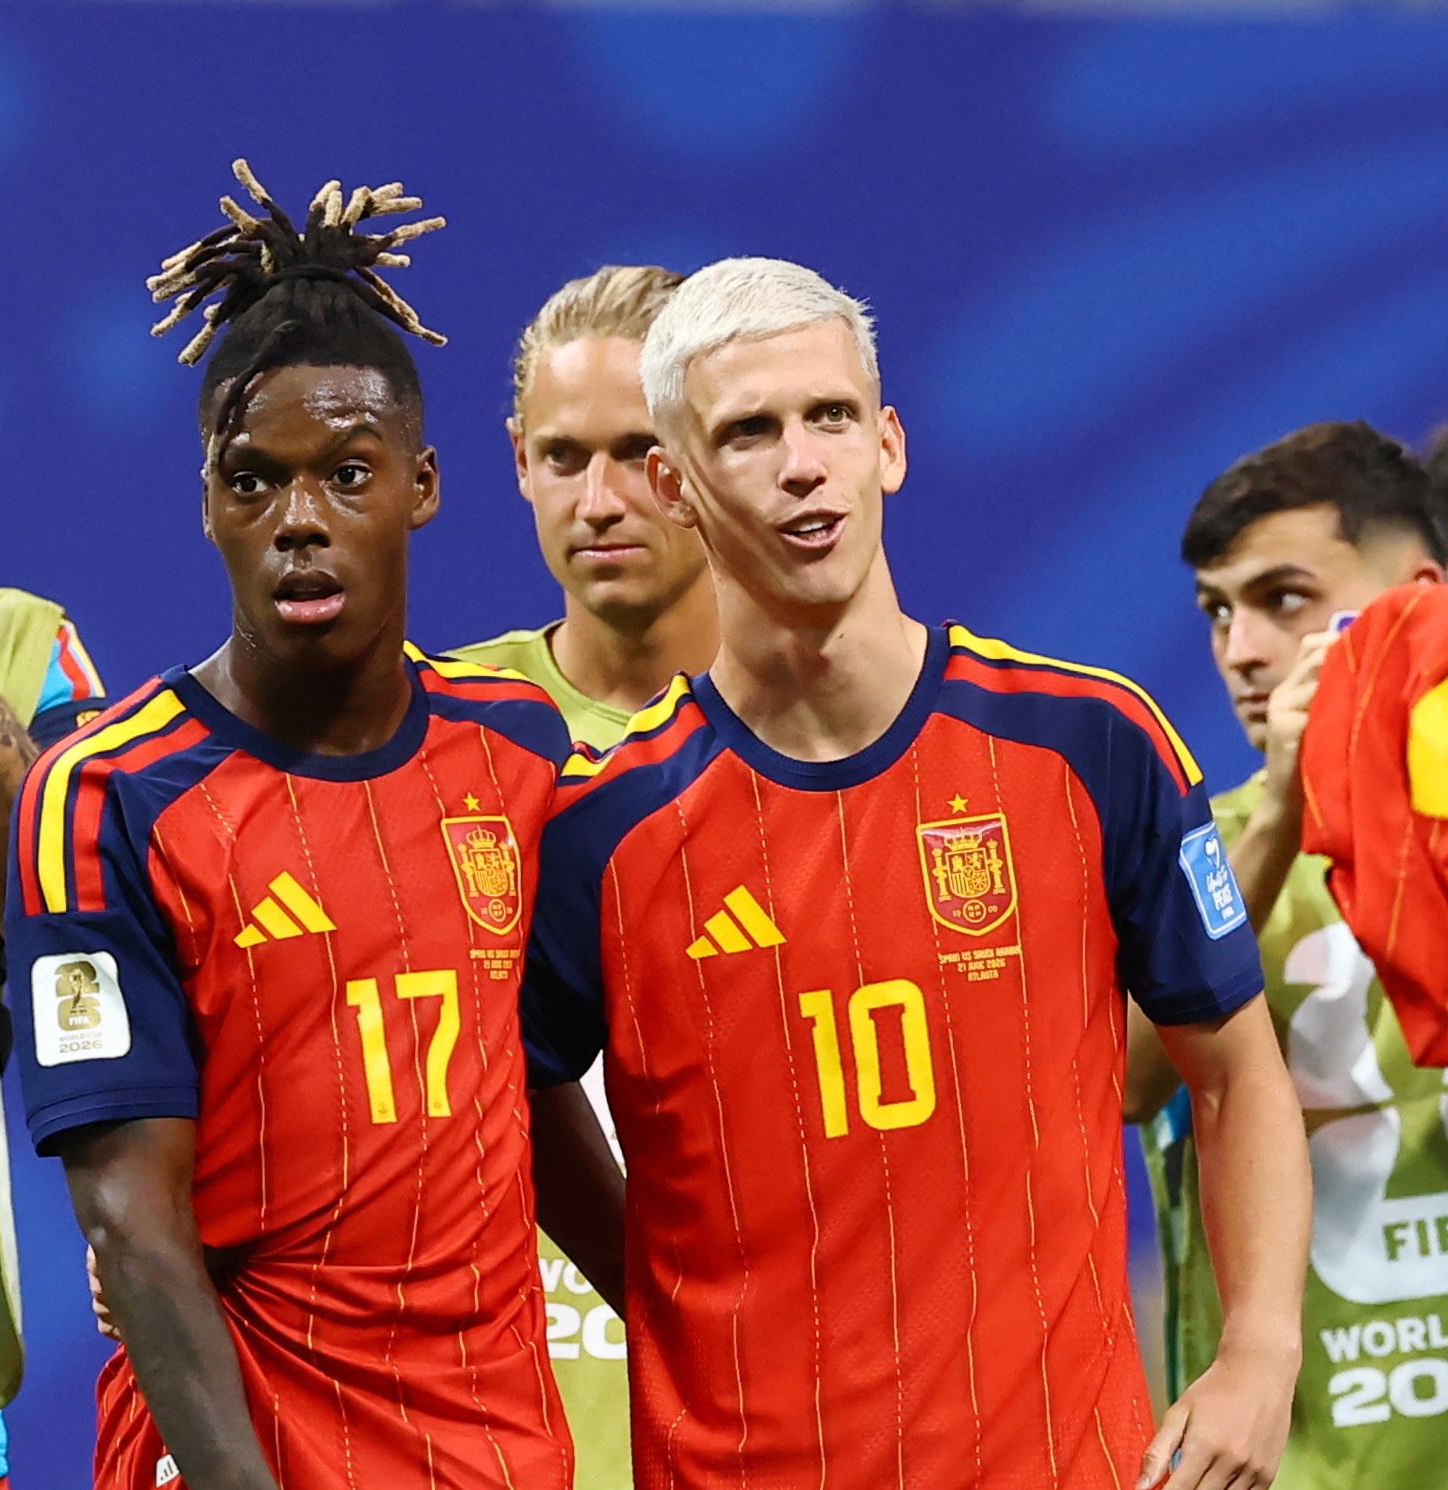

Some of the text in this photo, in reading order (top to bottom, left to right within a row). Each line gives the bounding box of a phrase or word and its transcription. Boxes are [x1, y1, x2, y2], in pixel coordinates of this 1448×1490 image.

[68, 1014, 91, 1026] FIFA
[59, 1034, 86, 1042] WORLD
[59, 1040, 103, 1053] 2026
[346, 969, 460, 1123] 17
[799, 978, 937, 1139] 10
[545, 1302, 627, 1360] 20
